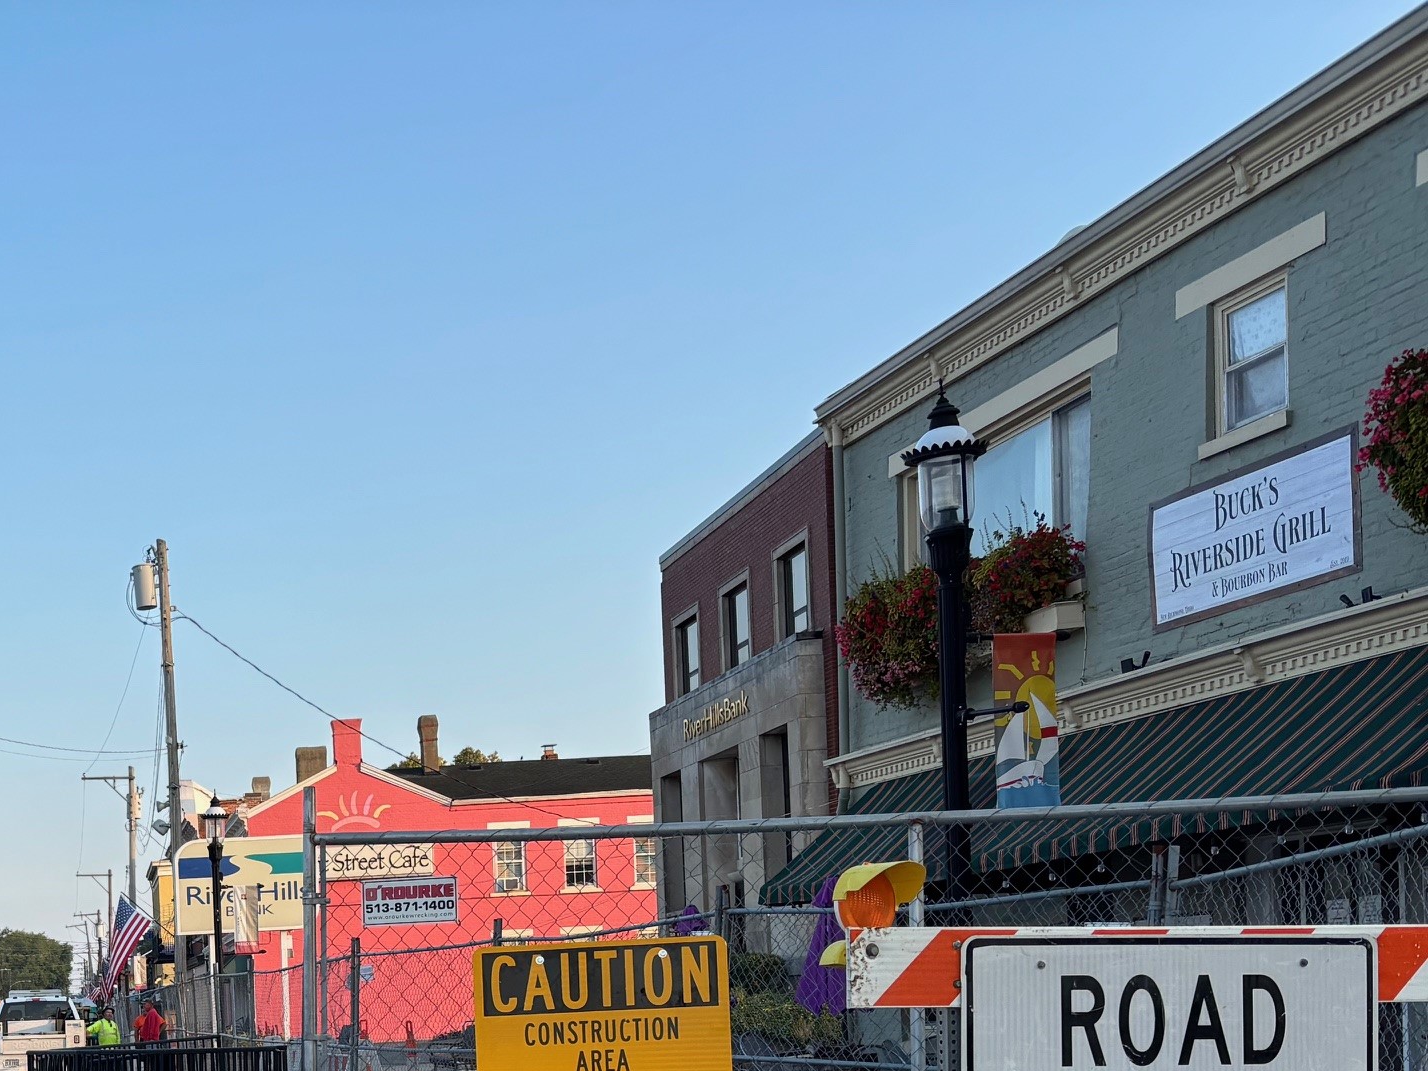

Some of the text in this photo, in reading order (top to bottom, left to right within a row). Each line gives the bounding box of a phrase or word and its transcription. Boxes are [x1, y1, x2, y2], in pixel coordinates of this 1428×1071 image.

[1212, 476, 1279, 532] BUCK'S
[1170, 506, 1331, 592] RIVERSIDE GRILL
[1212, 561, 1288, 598] & BOURBON BAR
[683, 690, 749, 742] RiverHillsBank
[333, 852, 384, 871] Street
[256, 881, 303, 901] Hill
[366, 884, 454, 901] O'ROURKE
[366, 900, 454, 914] 513-871-1400
[491, 946, 711, 1012] CAUTION
[525, 1016, 680, 1046] CONSTRUCTION
[1060, 974, 1286, 1068] ROAD
